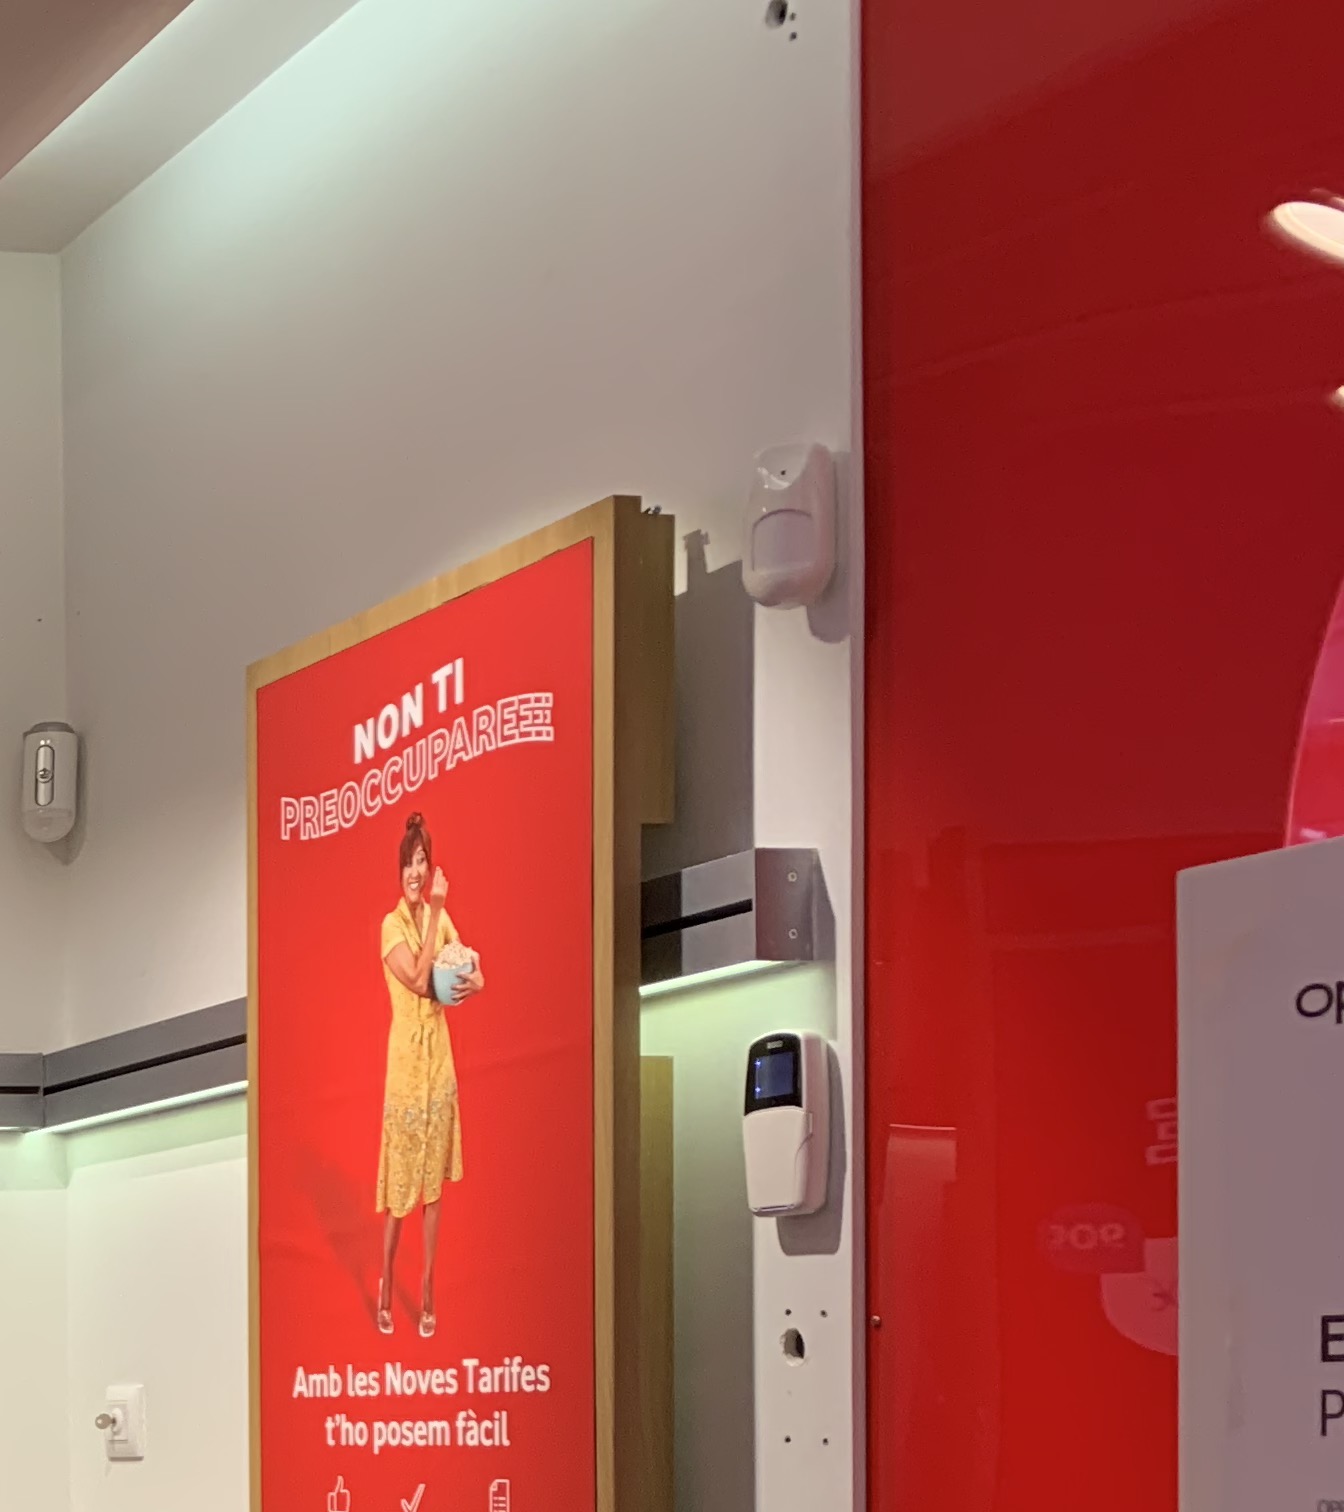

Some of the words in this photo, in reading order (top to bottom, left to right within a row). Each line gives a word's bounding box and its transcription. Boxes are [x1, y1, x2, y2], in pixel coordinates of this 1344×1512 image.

[354, 682, 423, 764] NON
[432, 657, 464, 713] TI
[292, 1365, 343, 1399] Amb
[346, 1363, 380, 1398] les
[384, 1362, 459, 1396] Noves
[462, 1356, 551, 1394] Tarifes
[325, 1414, 368, 1447] t'ho
[373, 1418, 450, 1455] posem
[455, 1409, 510, 1447] fàcil
